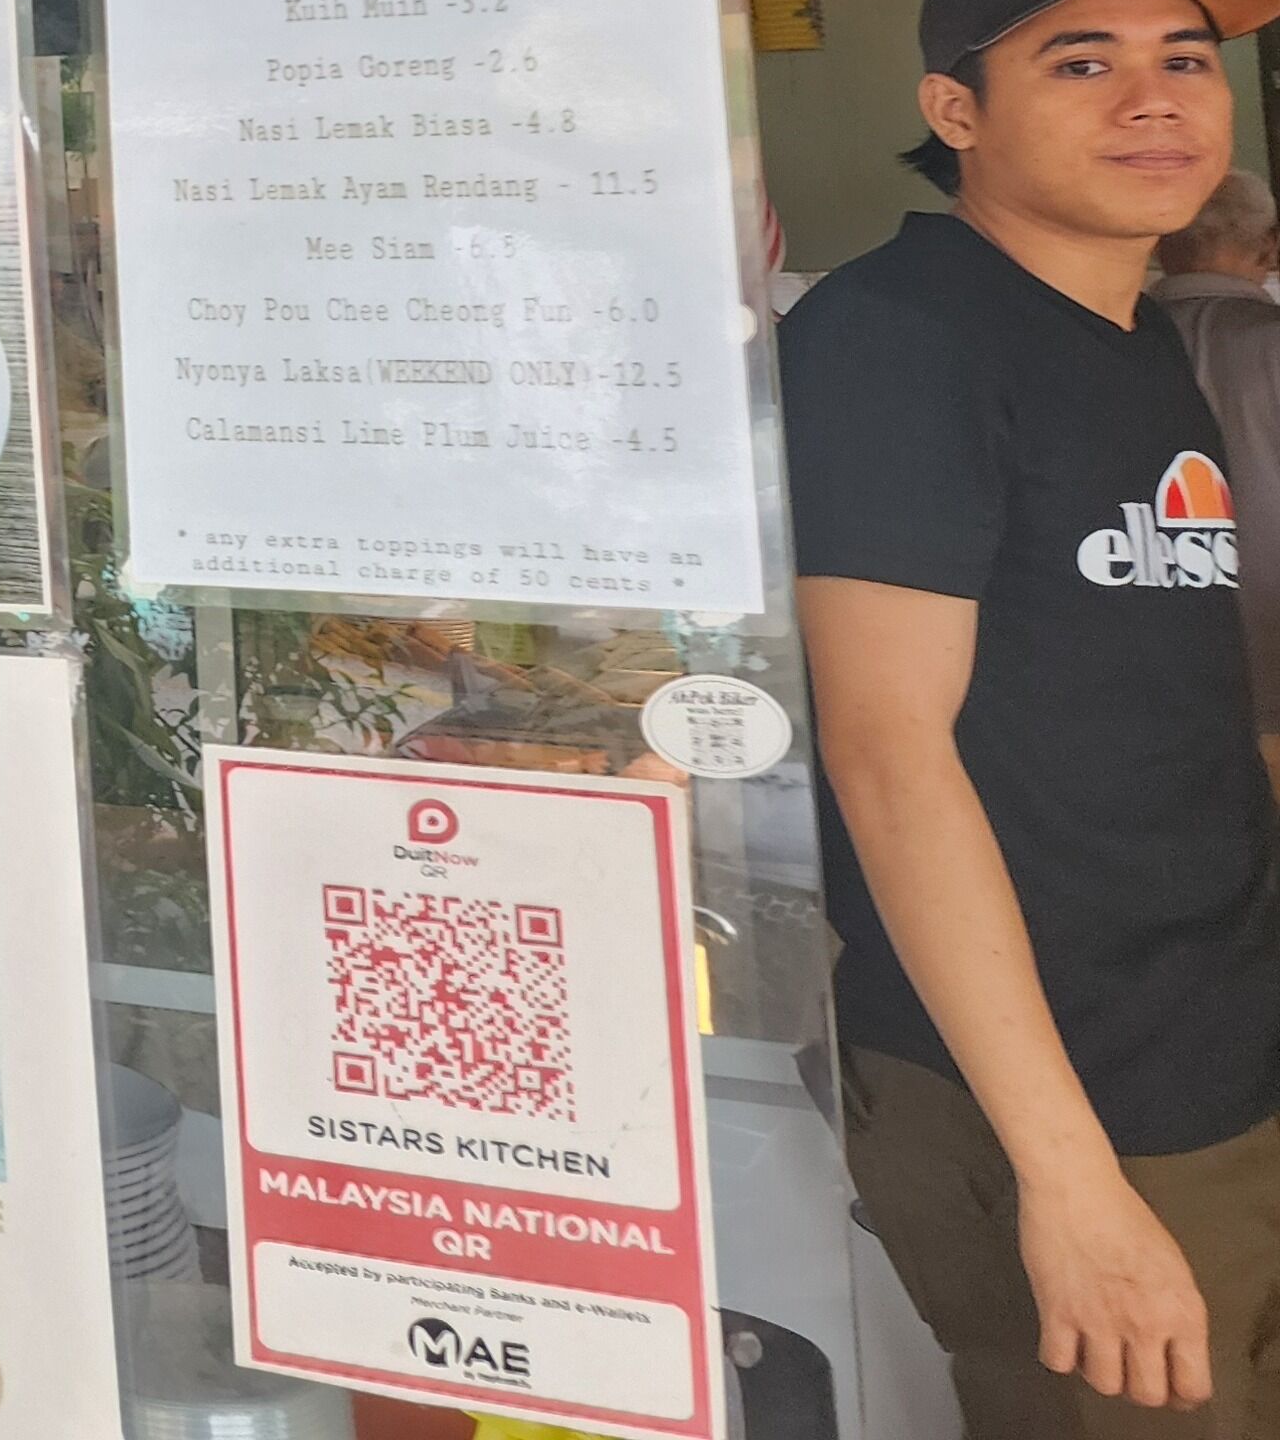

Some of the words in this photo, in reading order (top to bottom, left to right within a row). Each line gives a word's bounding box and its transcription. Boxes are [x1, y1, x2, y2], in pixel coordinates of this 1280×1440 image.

[266, 54, 344, 87] Popia
[358, 53, 456, 81] Goreng
[238, 116, 300, 142] Nasi
[314, 114, 395, 141] Lemak
[411, 112, 493, 138] Biasa
[173, 177, 234, 203] Nasi
[248, 176, 328, 201] Lemak
[341, 174, 409, 207] Ayam
[422, 172, 540, 203] Rendang
[589, 168, 659, 197] 11.5
[305, 236, 355, 261] Mee
[371, 235, 436, 261] Siam
[186, 297, 247, 328] Choy
[263, 298, 311, 323] Pou
[326, 297, 391, 323] Chee
[405, 297, 507, 329] Cheong
[521, 295, 573, 323] Fun
[174, 357, 267, 387] Nyonya
[185, 416, 326, 444] Calamansi
[341, 419, 405, 447] Lime
[422, 422, 490, 449] Plum
[505, 423, 591, 451] Juice
[205, 532, 249, 551] any
[265, 533, 341, 550] extra
[356, 537, 483, 560] toppings
[498, 541, 565, 561] will
[582, 544, 649, 564] have
[669, 551, 703, 566] an
[192, 554, 342, 577] additional
[357, 563, 452, 586] charge
[471, 568, 501, 585] of
[519, 569, 550, 587] 50
[568, 574, 652, 592] cents
[393, 844, 479, 867] DuitNow
[420, 863, 449, 880] QR
[307, 1114, 444, 1156] SISTARS
[455, 1135, 611, 1180] KITCHEN
[257, 1168, 453, 1224] MALAYSIA
[462, 1198, 677, 1256] NATIONAL
[431, 1228, 493, 1262] QR
[288, 1254, 359, 1279] Accepted
[362, 1267, 383, 1283] by
[386, 1271, 486, 1301] participating
[540, 1295, 572, 1312] and
[406, 1316, 532, 1379] MAE
